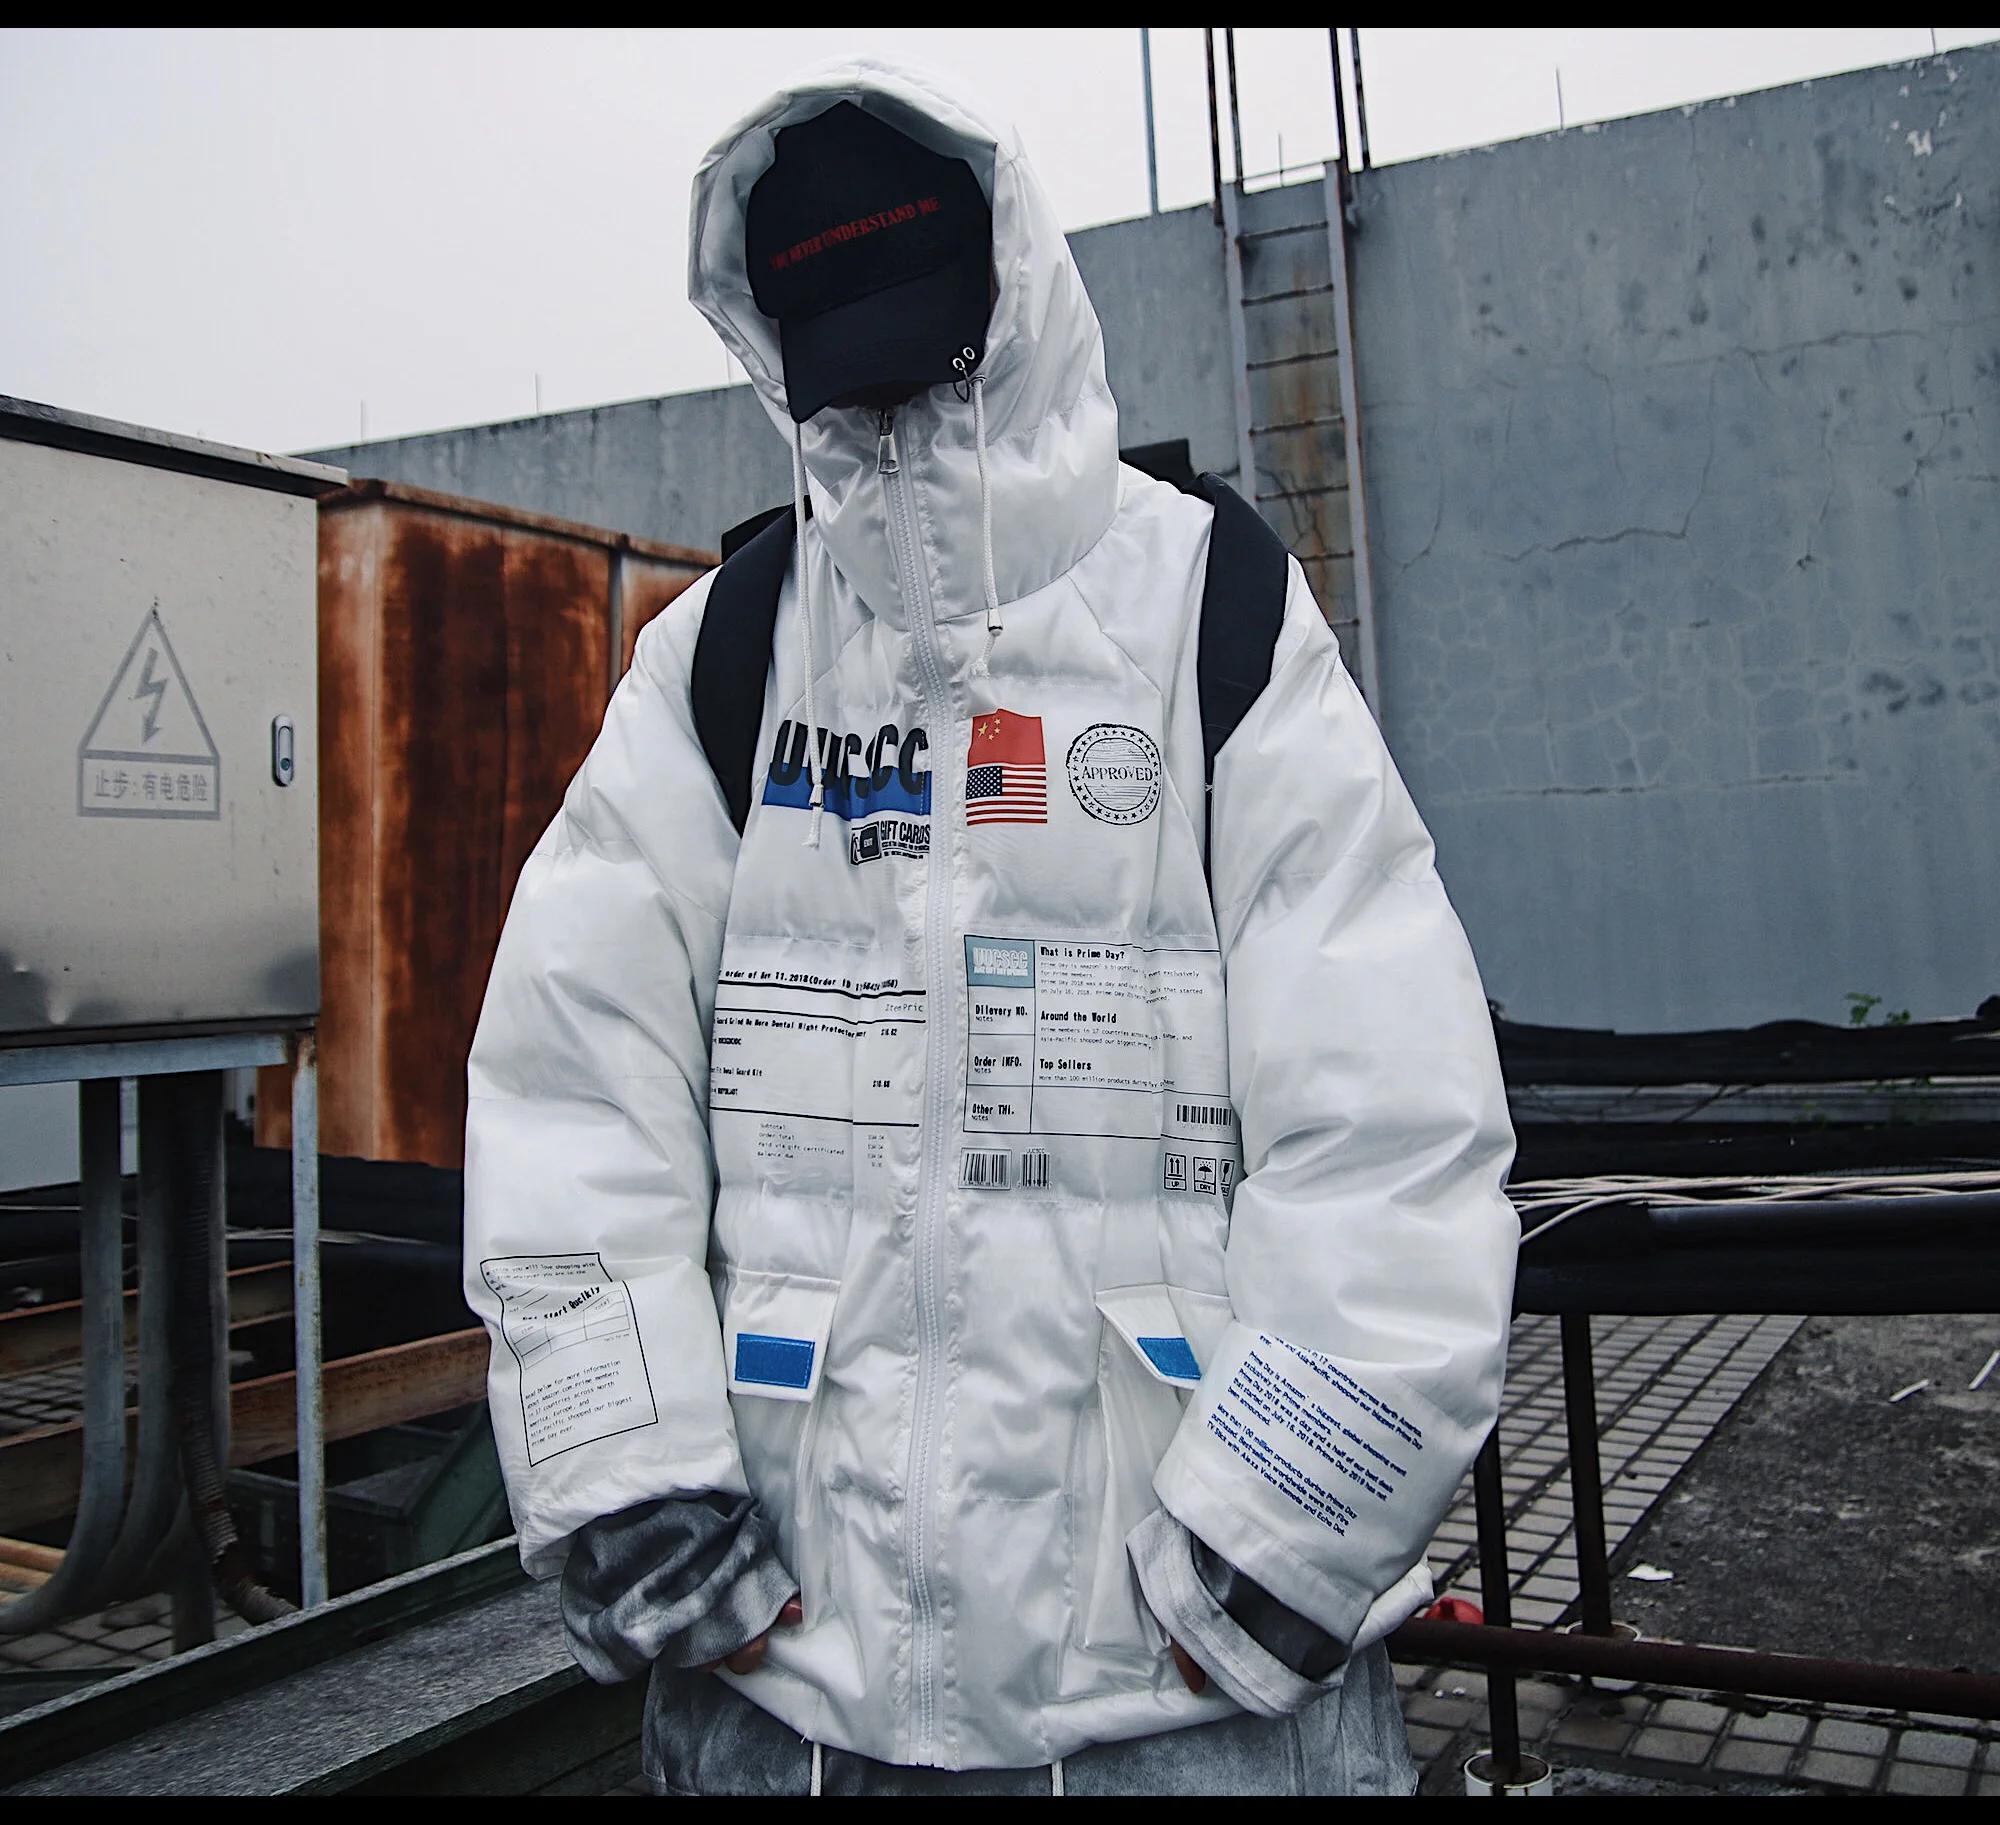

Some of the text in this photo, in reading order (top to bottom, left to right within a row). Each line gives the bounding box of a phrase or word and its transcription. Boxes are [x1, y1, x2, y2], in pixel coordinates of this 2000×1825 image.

[788, 236, 823, 262] NEVER
[821, 203, 917, 248] UNDERSTAND
[918, 196, 941, 215] ME
[1081, 765, 1153, 781] APPROVED
[880, 820, 931, 845] GIFT CARDS
[1040, 946, 1125, 960] What is Prime Day?
[748, 971, 757, 979] of
[1040, 1010, 1117, 1023] Around the World
[974, 1055, 1022, 1067] Order INFO.
[1039, 1058, 1092, 1071] Top Sellers
[972, 1103, 994, 1115] Other
[537, 1383, 552, 1394] below
[554, 1377, 564, 1385] for
[566, 1372, 580, 1380] more
[583, 1360, 621, 1375] information
[595, 1370, 620, 1381] members
[1243, 1361, 1271, 1386] exclusively
[1272, 1383, 1282, 1394] for
[1281, 1391, 1301, 1410] Prime
[543, 1396, 571, 1413] countries
[573, 1388, 594, 1399] across
[596, 1381, 615, 1391] North
[578, 1399, 590, 1408] and
[1227, 1385, 1240, 1399] been
[1295, 1351, 1331, 1381] Asia-Pacific
[1331, 1379, 1360, 1403] shopped
[1359, 1401, 1371, 1412] our
[1371, 1409, 1395, 1430] biggest
[1395, 1426, 1412, 1442] Prime
[1327, 1364, 1358, 1389] countries
[1358, 1388, 1379, 1405] across
[1380, 1402, 1398, 1420] North
[567, 1408, 592, 1421] shopped
[594, 1405, 605, 1413] our
[607, 1396, 633, 1408] biggest
[1249, 1350, 1263, 1366] Prime
[1263, 1362, 1274, 1376] Day
[1342, 1428, 1363, 1445] global
[1362, 1443, 1390, 1466] shopping
[1390, 1463, 1407, 1477] event
[1238, 1368, 1253, 1383] Prime
[1252, 1380, 1263, 1393] Day
[1263, 1389, 1280, 1405] 2018
[1280, 1403, 1293, 1417] was
[1299, 1420, 1312, 1432] day
[1312, 1430, 1327, 1444] and
[1331, 1444, 1347, 1458] half
[1345, 1456, 1355, 1464] of
[1353, 1462, 1365, 1473] our
[1364, 1469, 1379, 1483] best
[531, 1437, 546, 1447] Prime
[547, 1432, 557, 1440] Day
[1233, 1377, 1244, 1389] that
[1243, 1387, 1263, 1405] started
[1262, 1404, 1271, 1412] on
[1271, 1410, 1284, 1424] July
[1314, 1444, 1335, 1463] Prime
[1335, 1459, 1348, 1474] Day
[1364, 1481, 1376, 1494] has
[1376, 1491, 1387, 1501] not
[1207, 1420, 1215, 1430] TV
[1214, 1427, 1227, 1442] Stick
[1227, 1441, 1240, 1454] with
[1240, 1452, 1259, 1470] Alexa
[1260, 1466, 1277, 1485] Voice
[1277, 1481, 1303, 1505] Remote
[1303, 1503, 1317, 1515] and
[1316, 1511, 1333, 1527] Echo
[1217, 1403, 1357, 1519] More than 100 million products during Prime Day
[1272, 1465, 1307, 1495] worldwide
[1308, 1493, 1324, 1508] were
[1325, 1505, 1336, 1516] the
[1335, 1512, 1349, 1526] Fire
